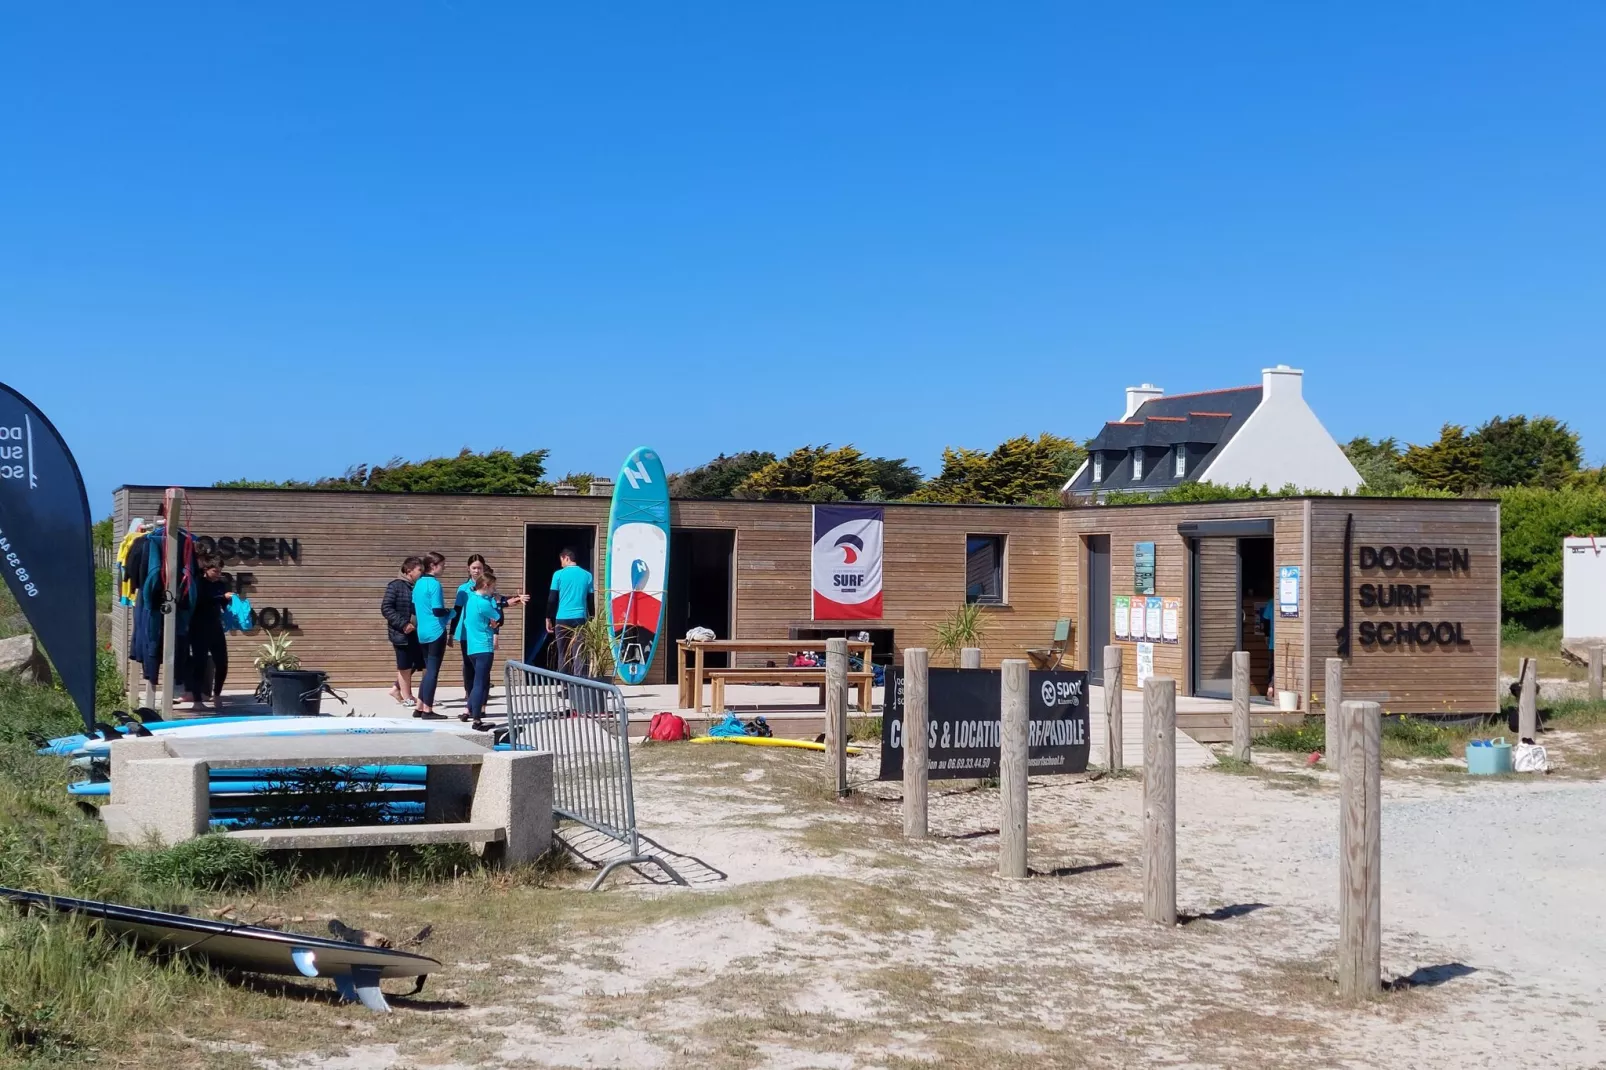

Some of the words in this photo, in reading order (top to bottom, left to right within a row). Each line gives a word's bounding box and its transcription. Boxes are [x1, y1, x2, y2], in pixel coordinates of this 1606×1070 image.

[197, 536, 298, 560] OSSEN
[1359, 546, 1469, 571] DOSSEN
[833, 574, 864, 587] SURF
[1358, 584, 1431, 608] SURF
[1358, 621, 1471, 645] SCHOOL
[1056, 680, 1083, 698] sport
[940, 721, 951, 748] &
[954, 720, 1001, 748] LOCATIO
[1028, 719, 1085, 746] RF/PADDLE
